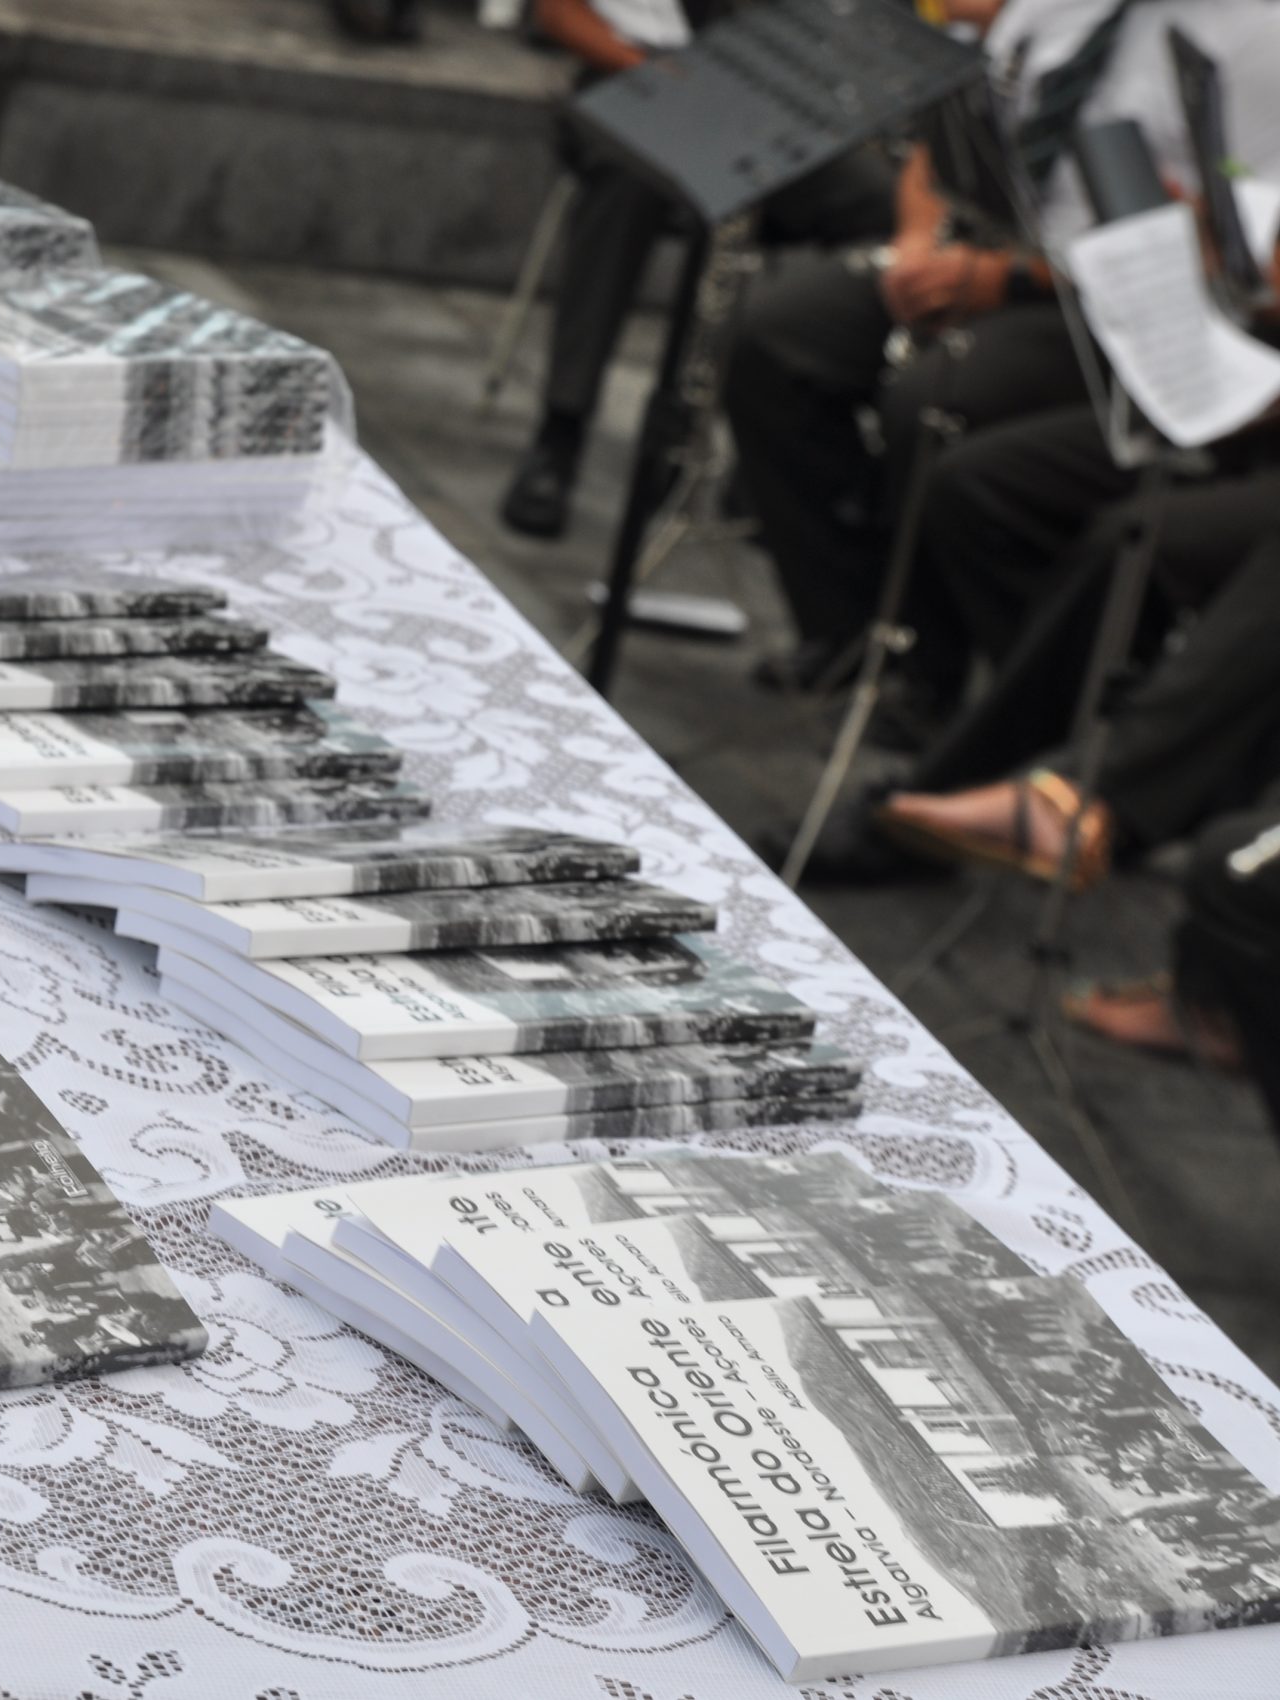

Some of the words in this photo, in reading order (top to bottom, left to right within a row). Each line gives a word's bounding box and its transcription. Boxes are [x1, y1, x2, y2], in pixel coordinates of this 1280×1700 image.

[578, 1236, 652, 1300] Açores
[615, 1233, 662, 1277] Amaro
[678, 1316, 749, 1385] Açores
[717, 1314, 765, 1362] Amaro
[639, 1317, 753, 1437] Oriente
[761, 1364, 808, 1413] Adélio
[625, 1366, 811, 1576] Filarmónica
[751, 1448, 802, 1495] do
[756, 1406, 846, 1502] Nordeste
[794, 1507, 909, 1627] Estrela
[854, 1526, 944, 1621] Algarvia
